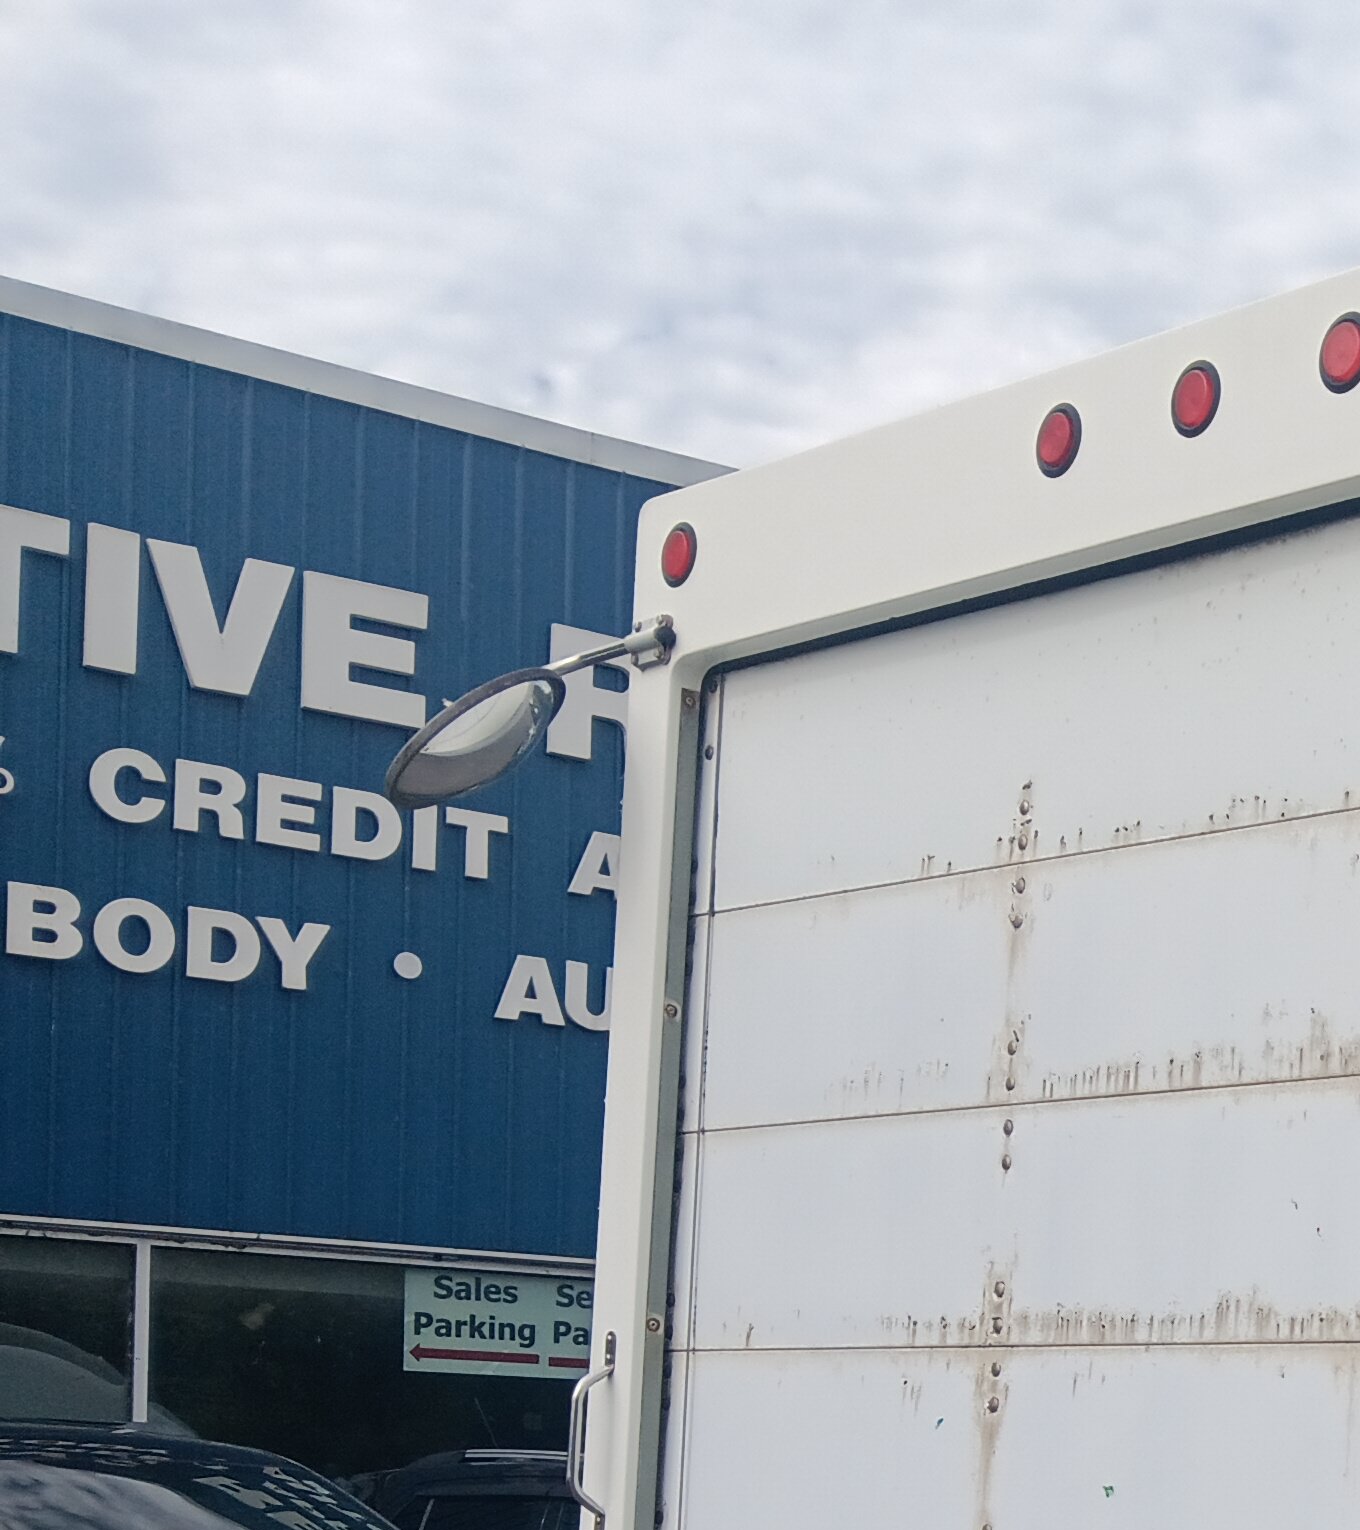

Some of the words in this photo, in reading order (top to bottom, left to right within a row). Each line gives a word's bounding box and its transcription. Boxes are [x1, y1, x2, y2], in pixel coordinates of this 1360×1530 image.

[89, 748, 509, 880] CREDIT
[6, 881, 331, 991] BODY
[433, 1275, 518, 1304] Sales
[413, 1311, 536, 1348] Parking
